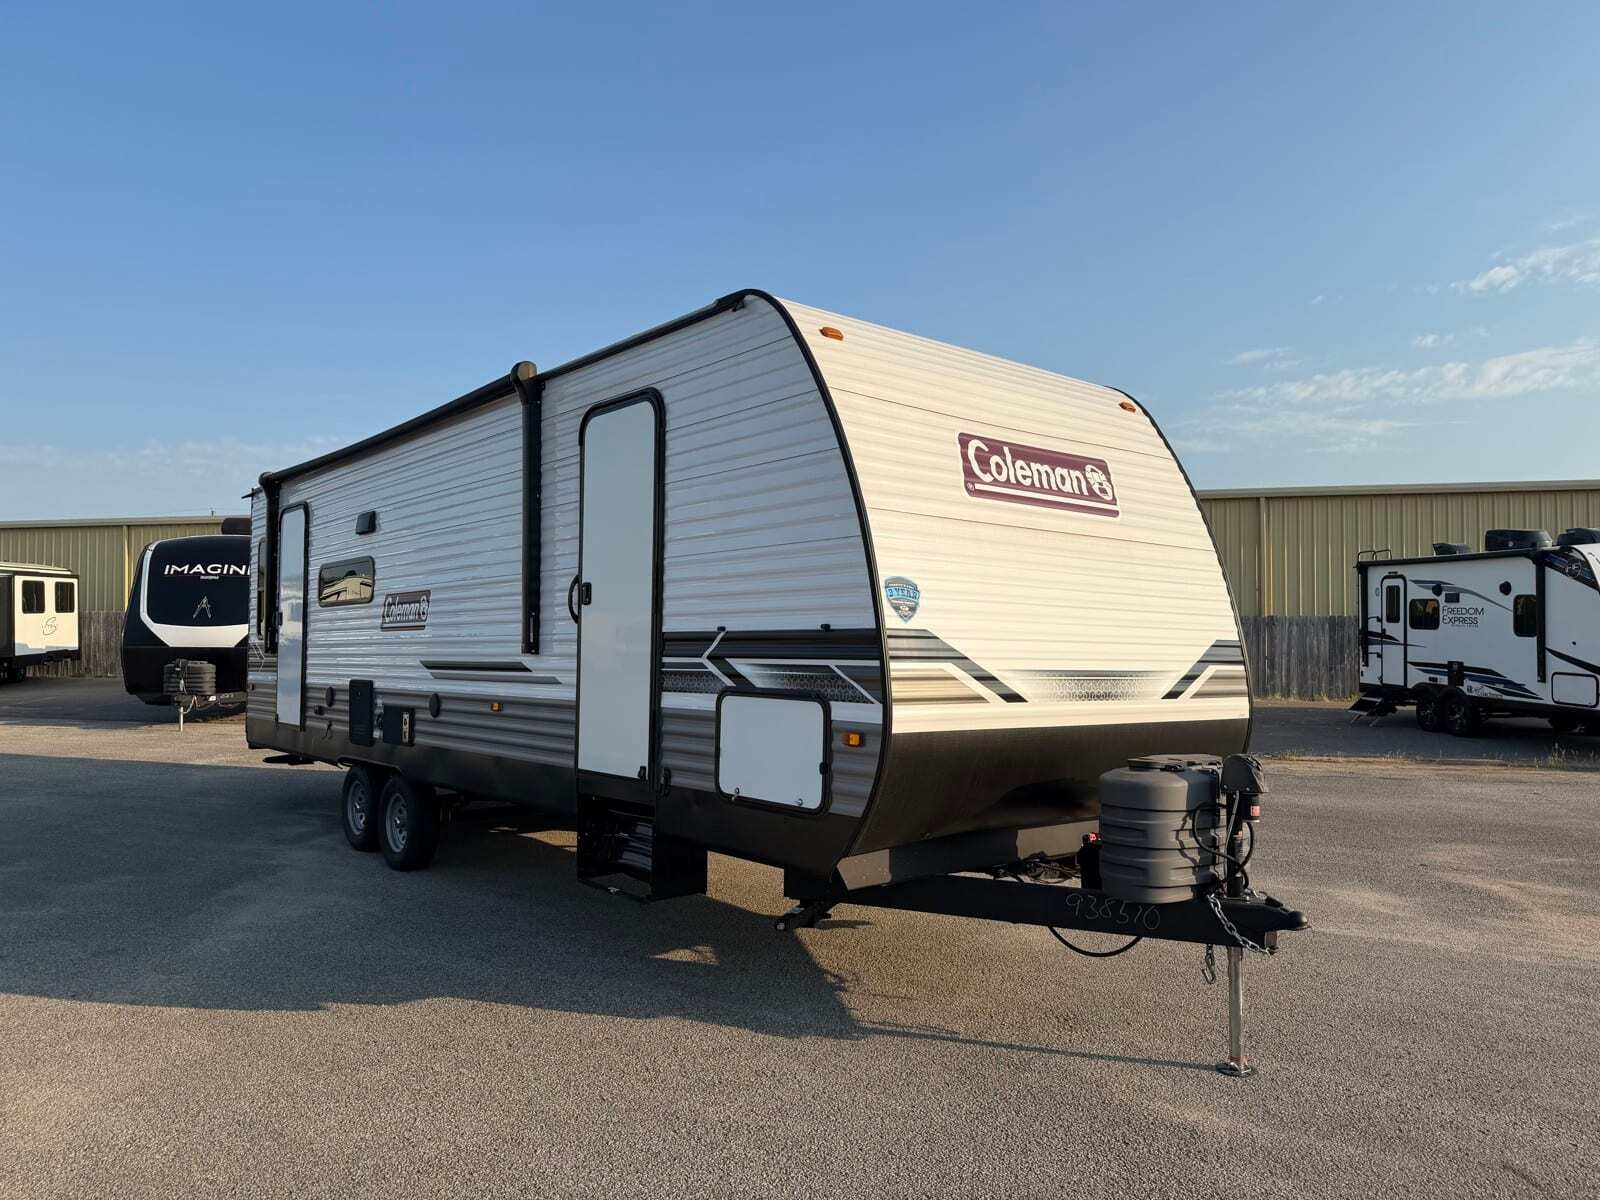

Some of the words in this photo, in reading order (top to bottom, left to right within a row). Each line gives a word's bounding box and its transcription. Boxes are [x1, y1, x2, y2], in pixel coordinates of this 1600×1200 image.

[967, 439, 1088, 496] Coleman
[384, 595, 420, 623] Coleman
[1442, 604, 1485, 616] FREEDOM
[1442, 614, 1479, 625] EXPRESS
